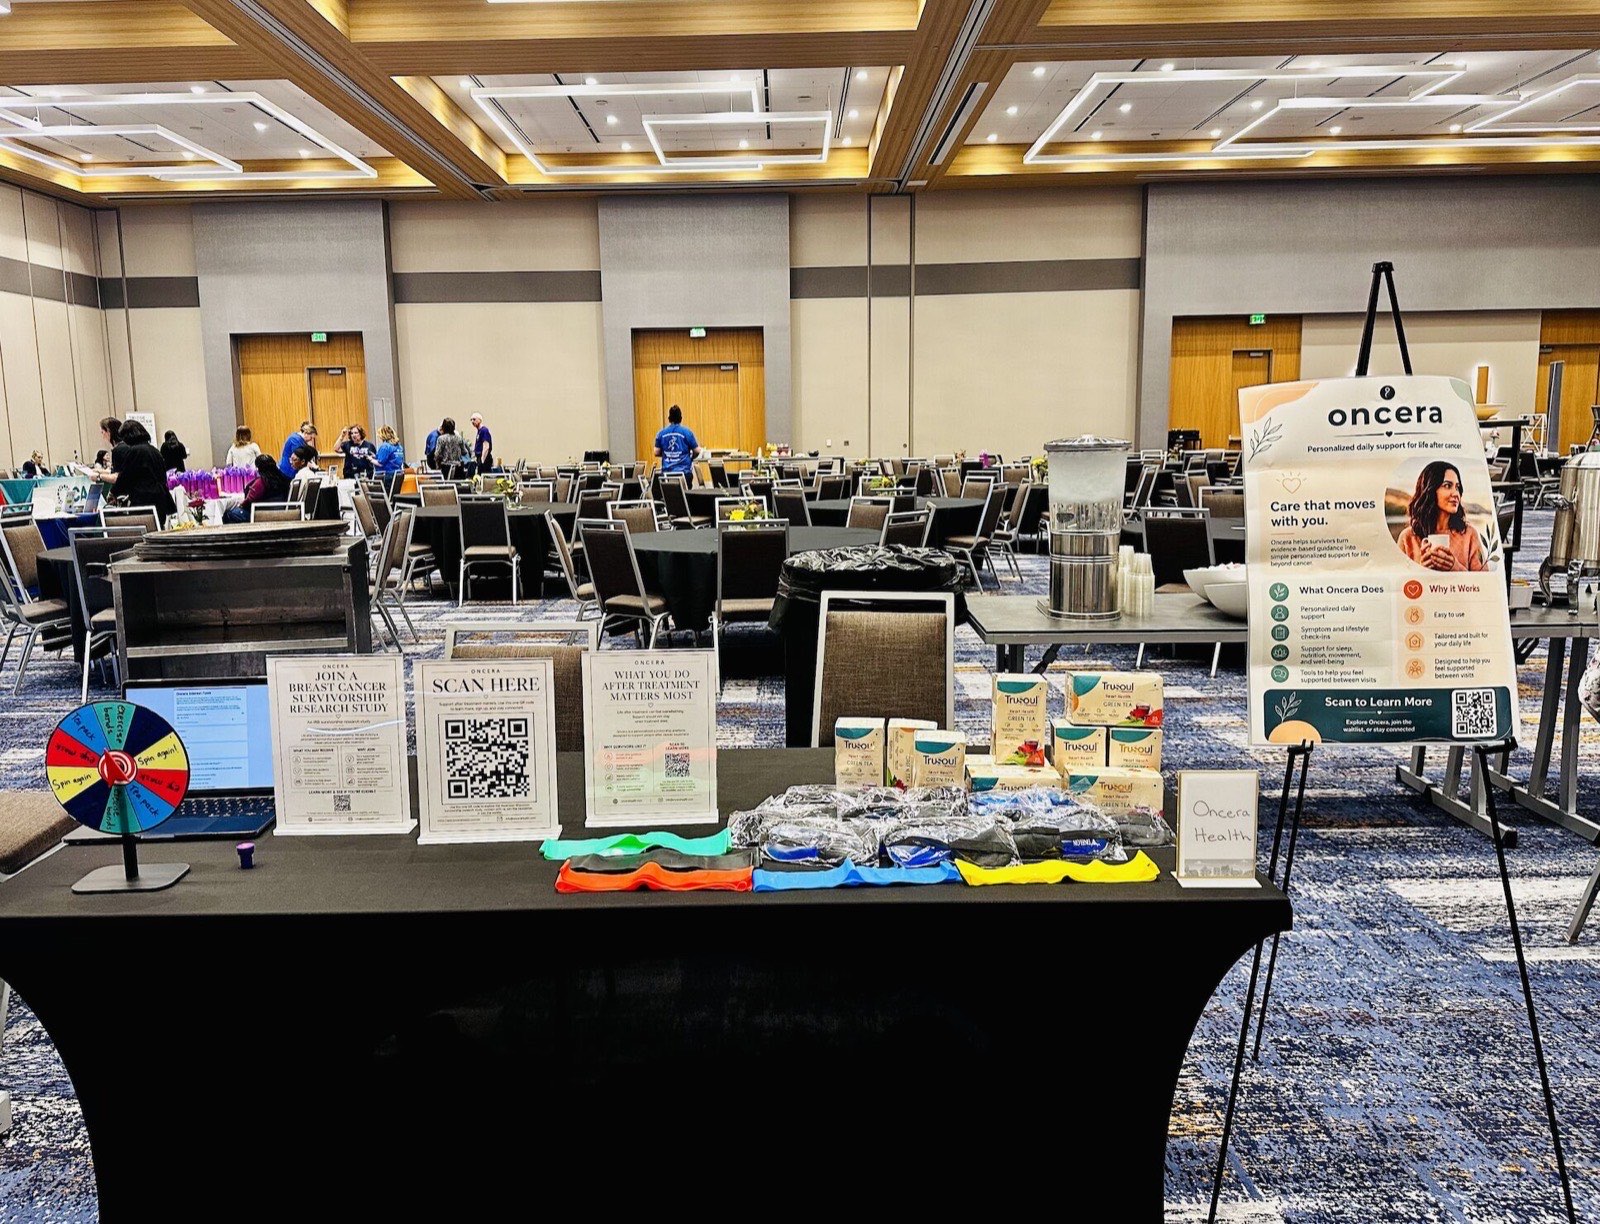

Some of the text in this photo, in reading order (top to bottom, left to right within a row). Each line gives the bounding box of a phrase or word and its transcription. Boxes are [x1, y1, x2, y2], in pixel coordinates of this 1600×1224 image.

[1328, 406, 1442, 426] oncera
[1308, 444, 1354, 453] Personalized
[1357, 443, 1374, 452] daily
[1376, 442, 1405, 450] support
[1271, 500, 1375, 512] Care that moves
[1271, 516, 1328, 528] with you.
[1300, 585, 1384, 594] What Oncera Does
[1430, 585, 1448, 594] Why
[315, 671, 358, 681] JOIN A
[615, 670, 690, 679] WHAT YOU DO
[289, 682, 387, 692] BREAST CANCER
[433, 677, 540, 693] SCAN HERE
[602, 681, 700, 690] AFTER TREATMENT
[292, 693, 385, 703] SURVIVORSHIP
[610, 692, 693, 701] MATTERS MOST
[1325, 697, 1432, 706] Scan to Learn More
[290, 703, 389, 713] RESEARCH STUDY
[104, 707, 114, 734] bands
[72, 713, 96, 741] Tea pack
[138, 745, 178, 765] Spin again!
[52, 774, 92, 790] Spin again
[130, 784, 160, 818] Tea pack
[1193, 800, 1250, 818] Oncera
[1194, 827, 1251, 842] Health
